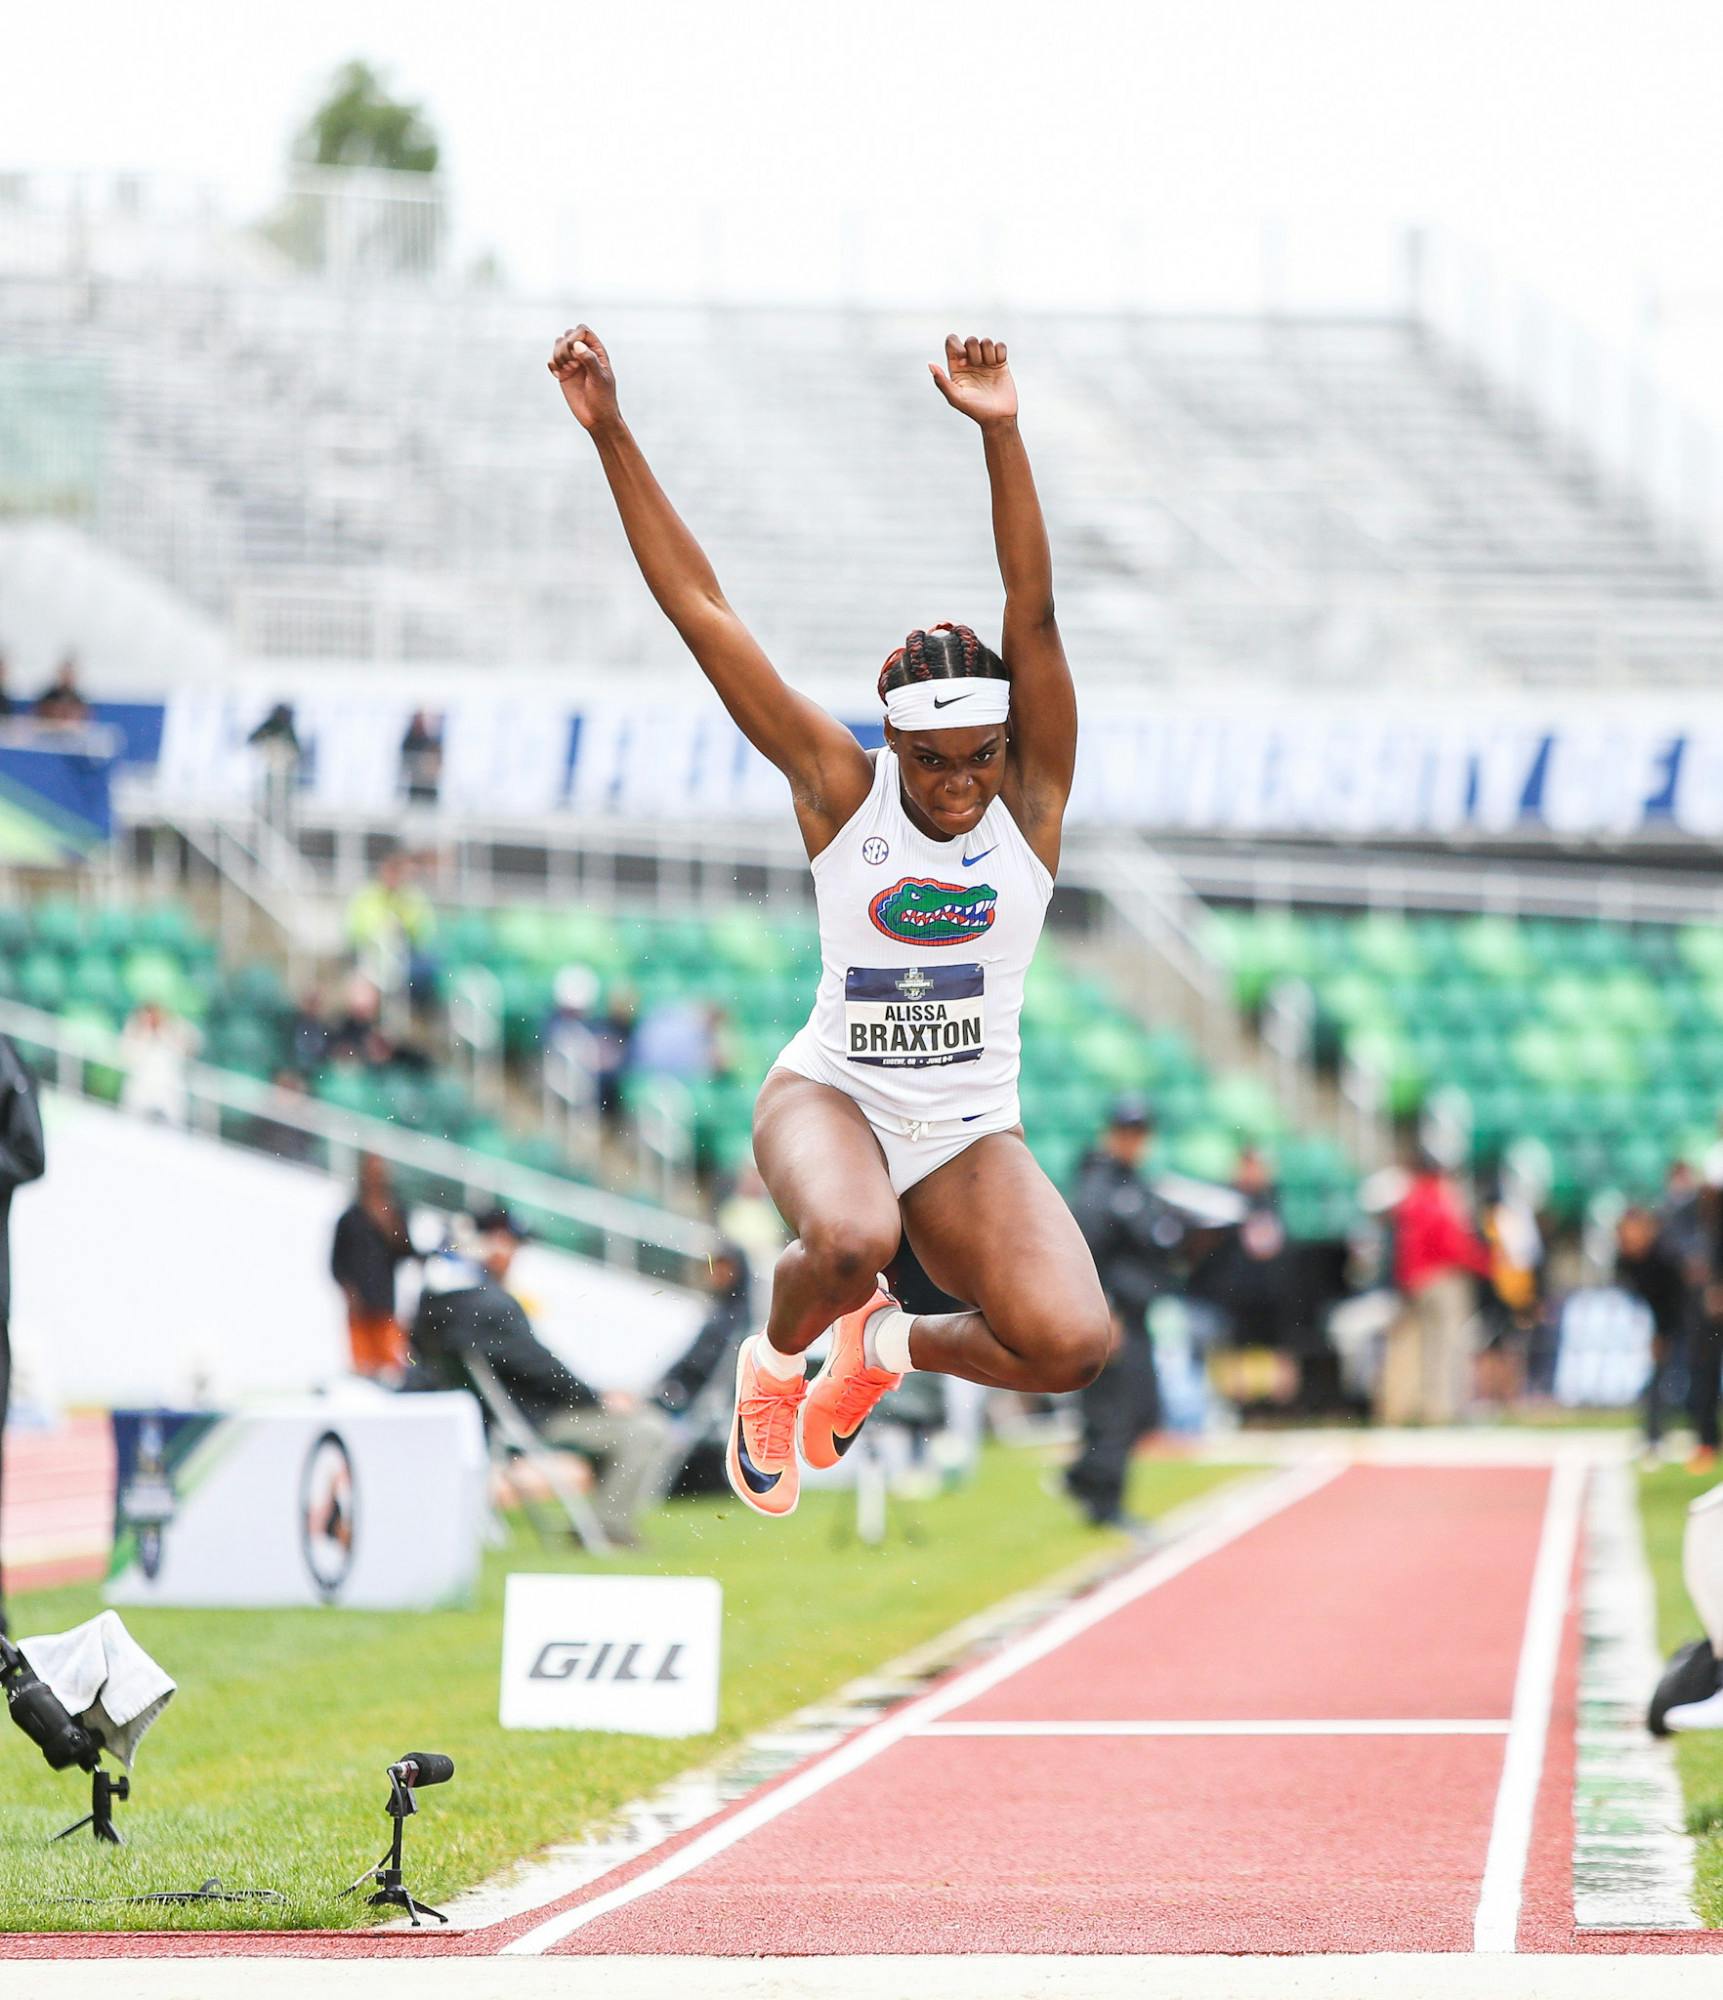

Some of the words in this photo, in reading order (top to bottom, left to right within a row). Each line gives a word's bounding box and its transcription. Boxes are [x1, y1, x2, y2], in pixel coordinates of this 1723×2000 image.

[863, 838, 889, 864] SEC
[885, 1004, 947, 1021] ALISSA
[851, 1017, 981, 1052] BRAXTON
[529, 1642, 685, 1680] GILL
